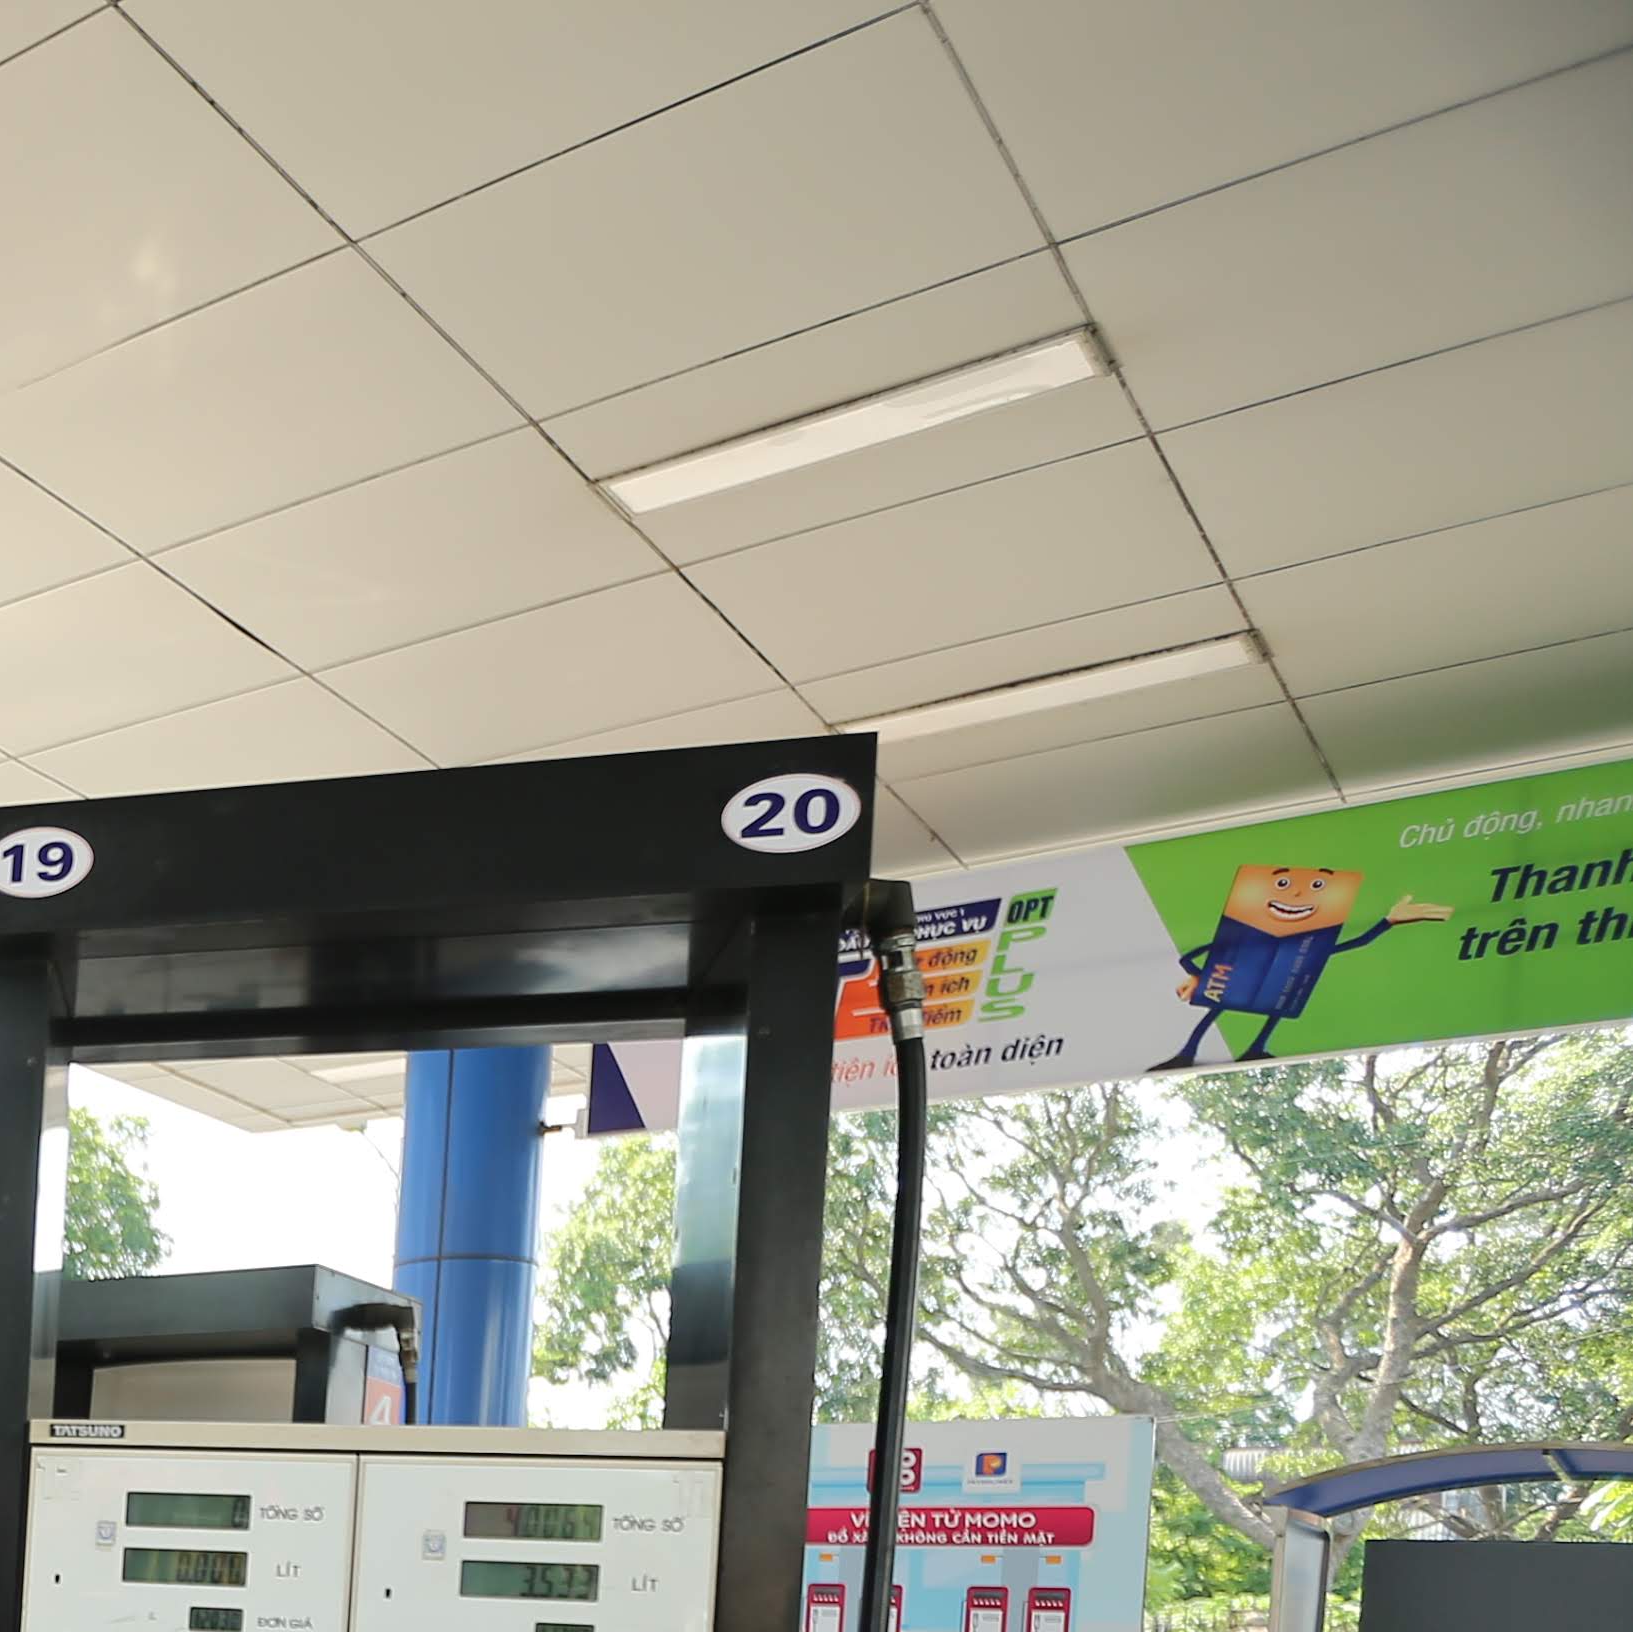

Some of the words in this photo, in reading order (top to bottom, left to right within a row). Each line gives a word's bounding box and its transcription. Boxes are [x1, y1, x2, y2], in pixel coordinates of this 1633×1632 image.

[740, 787, 841, 837] 20
[1399, 818, 1455, 848] Chủ
[1463, 809, 1543, 841] động,
[1555, 793, 1633, 824] nhan
[1, 841, 75, 884] 19
[1007, 896, 1054, 924] OPT
[1458, 918, 1560, 961] trên
[1576, 906, 1633, 945] th
[928, 948, 978, 970] động
[1204, 964, 1233, 1003] ATM
[930, 1044, 992, 1071] toàn
[1001, 1034, 1064, 1066] diện
[52, 1425, 122, 1438] TATSUNO
[931, 1508, 962, 1528] TỬ
[965, 1512, 1036, 1528] MOMO
[952, 1528, 982, 1544] CẦN
[987, 1529, 1018, 1545] TIỀN
[1023, 1530, 1055, 1546] MẶT
[276, 1561, 302, 1578] LÍT
[631, 1573, 658, 1592] LÍT
